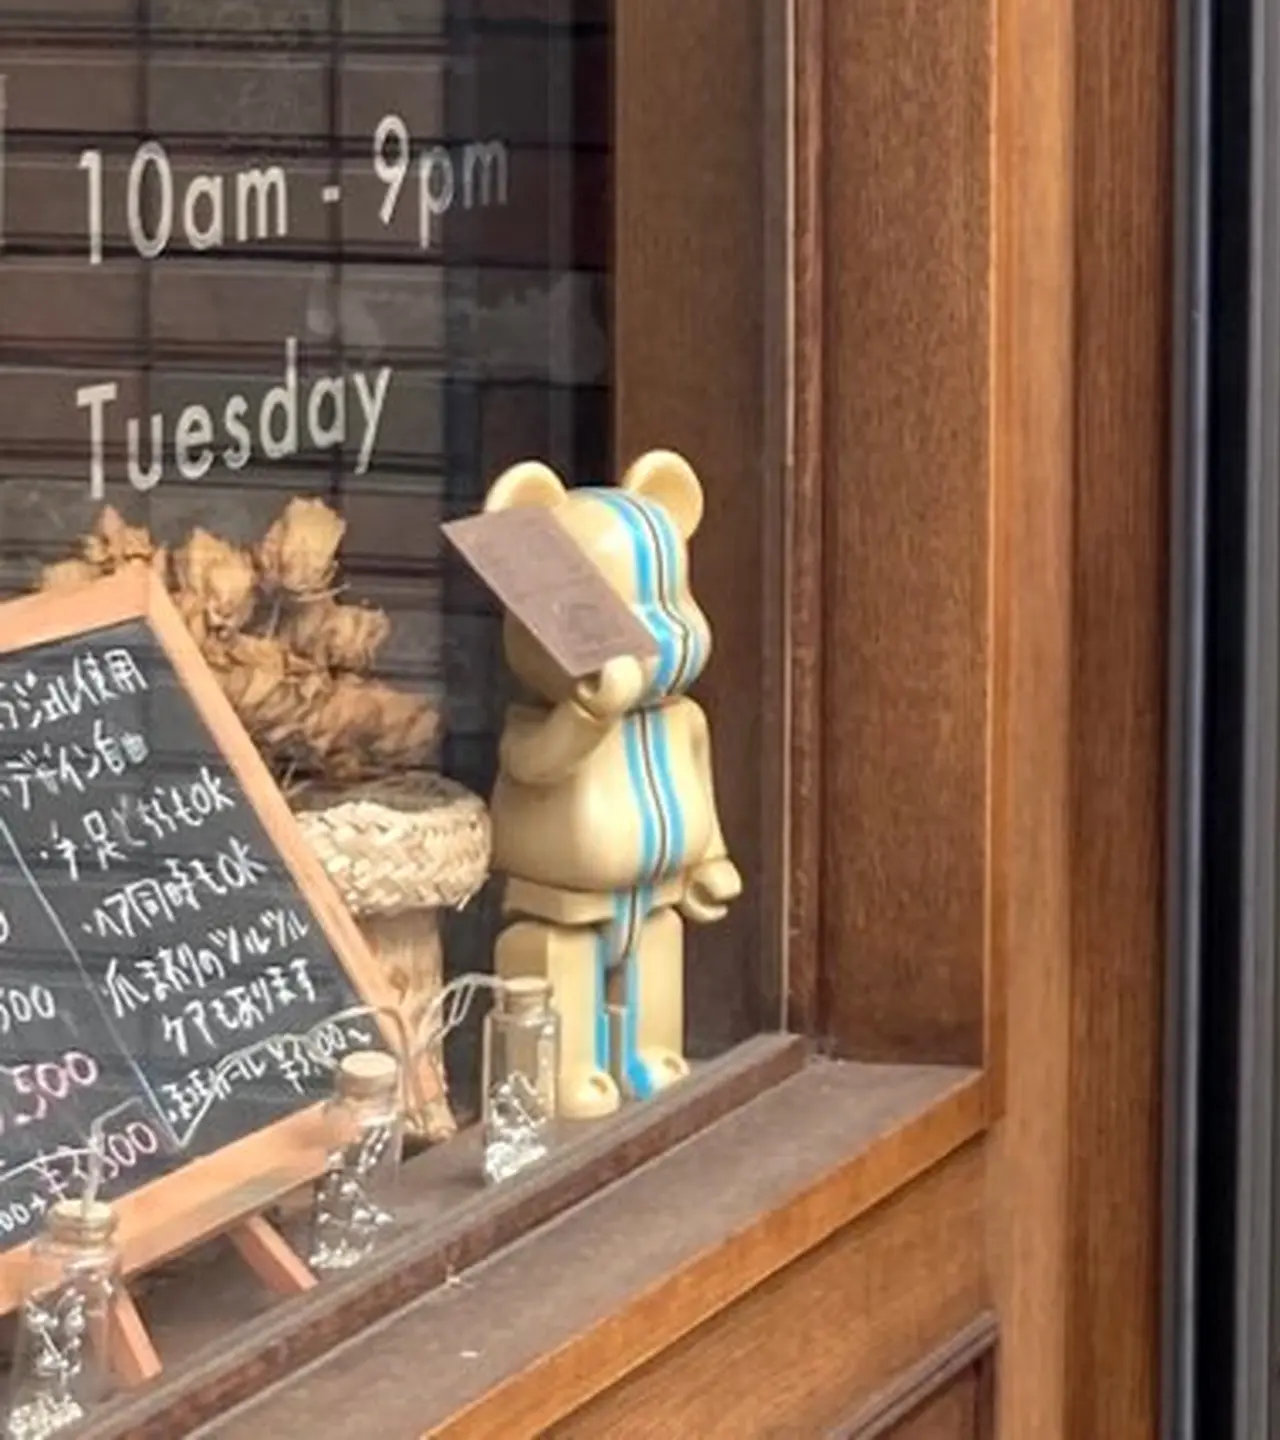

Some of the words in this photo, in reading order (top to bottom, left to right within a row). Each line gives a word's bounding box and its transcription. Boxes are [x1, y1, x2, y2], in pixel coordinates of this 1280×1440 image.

[78, 140, 289, 265] 10am
[372, 113, 509, 250] 9pm
[76, 337, 393, 499] Tuesday
